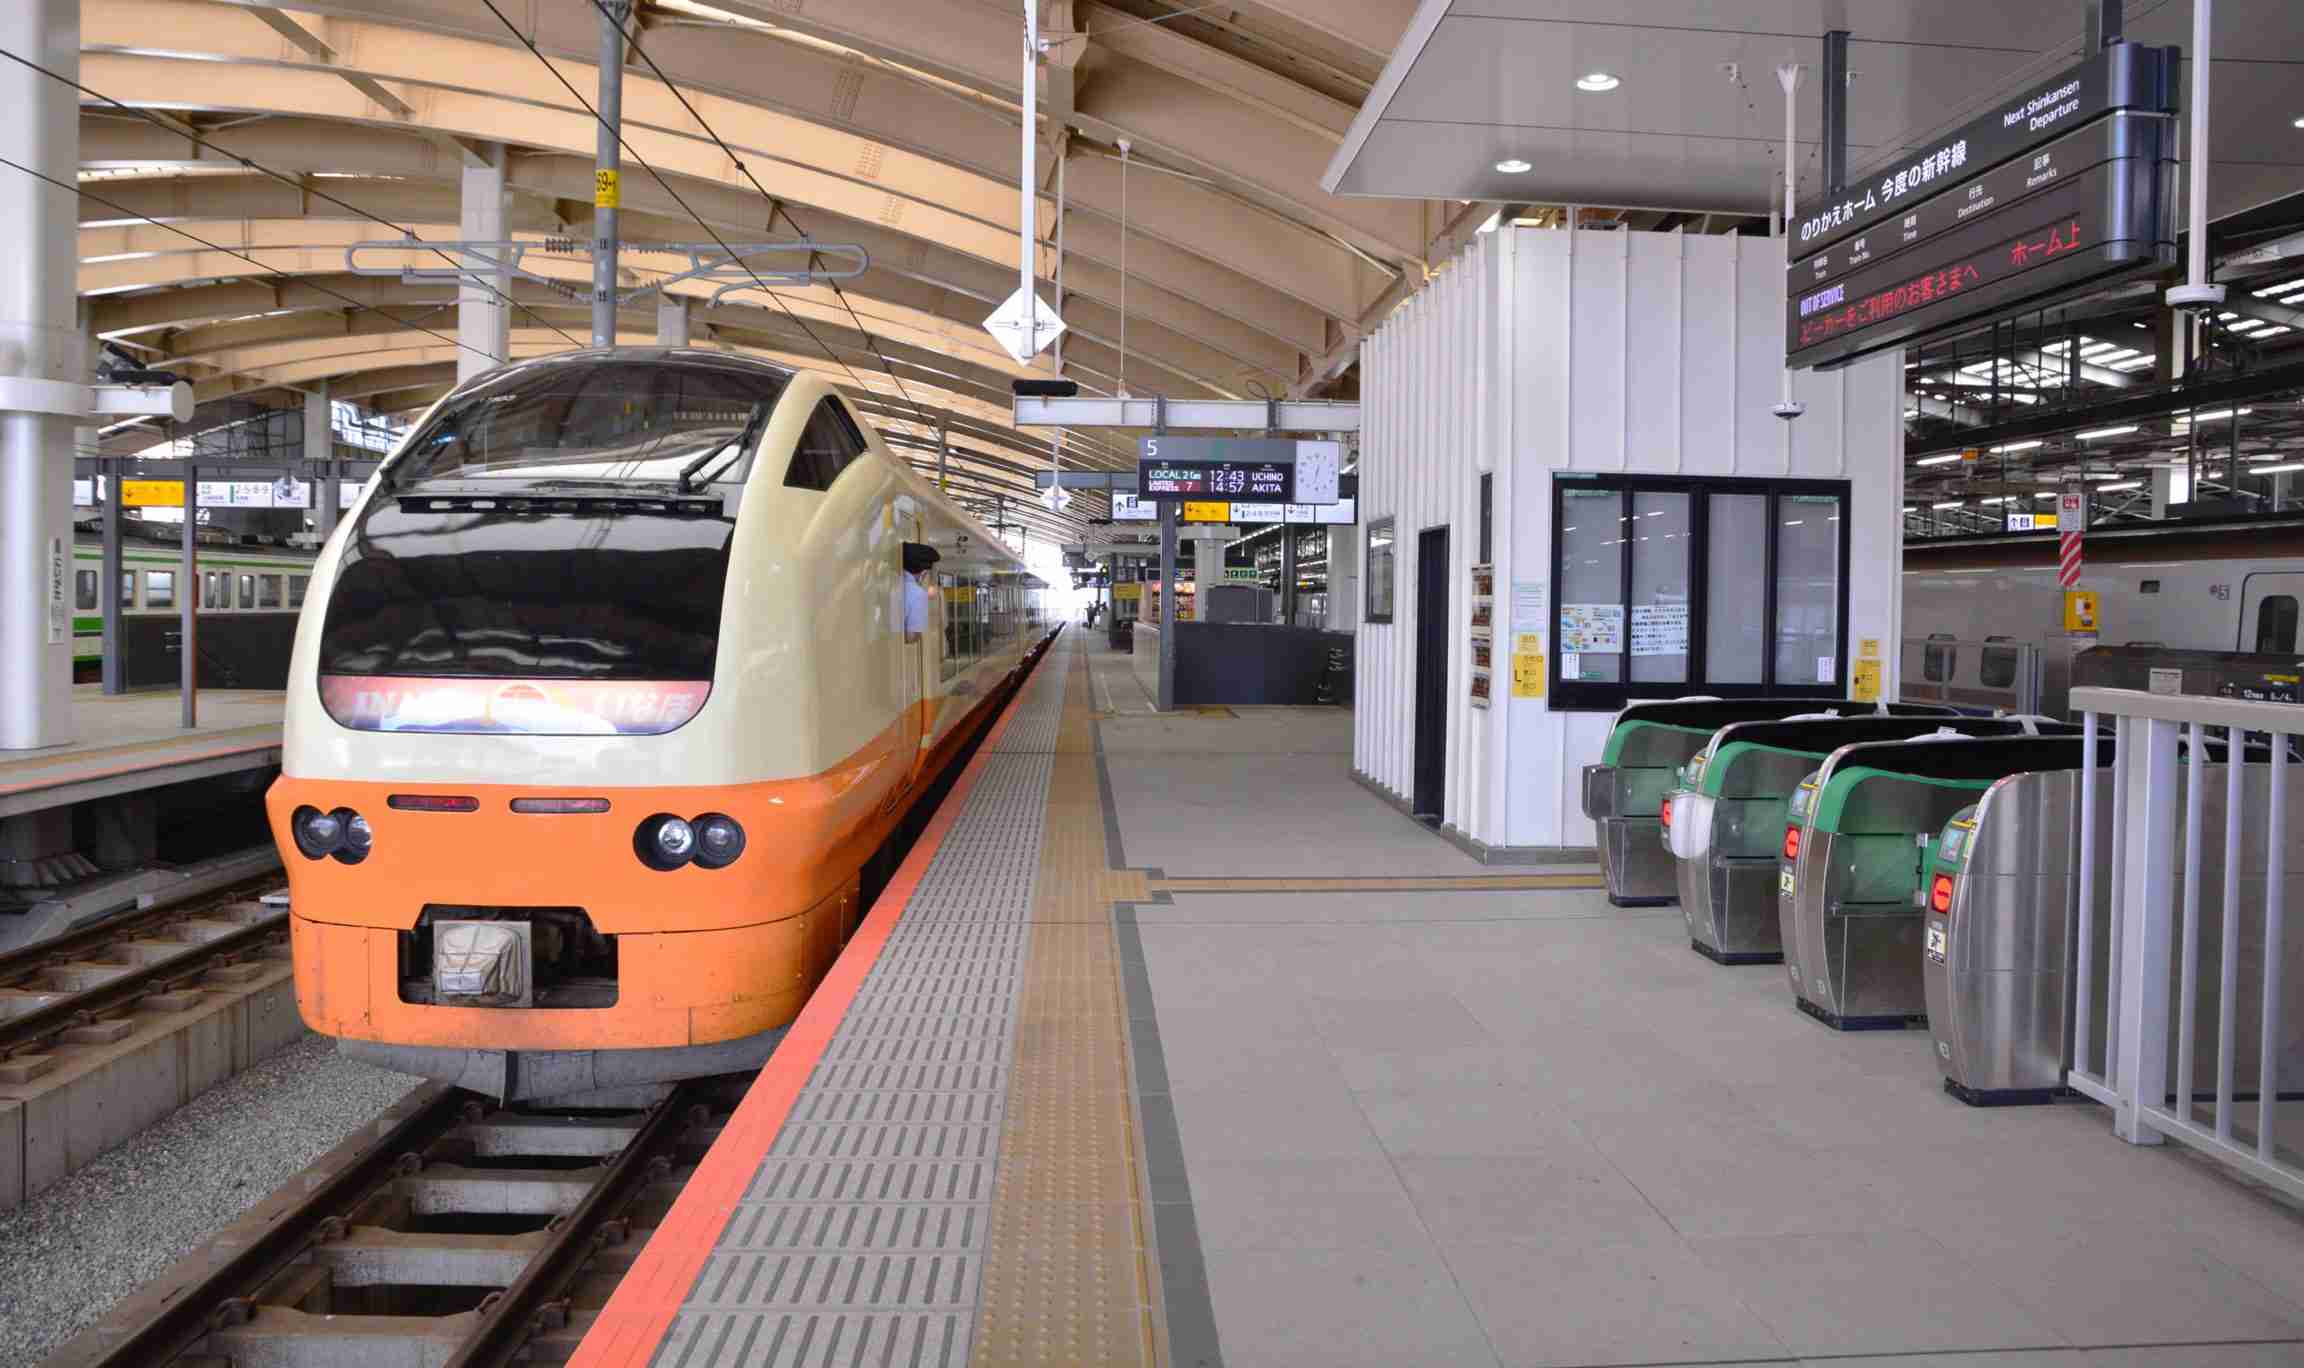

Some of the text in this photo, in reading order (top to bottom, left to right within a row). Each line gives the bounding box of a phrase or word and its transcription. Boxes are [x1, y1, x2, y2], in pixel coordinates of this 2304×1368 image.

[2003, 80, 2080, 128] Next Shinkansen
[2029, 99, 2080, 132] Departure
[2026, 168, 2058, 188] Remarks
[1800, 140, 1967, 242] のりかえホーム 今度の新幹線
[1957, 196, 1995, 219] Destination
[1147, 439, 1158, 456] 5
[1149, 469, 1182, 480] LOCAL
[1210, 470, 1245, 481] 12:43
[1251, 472, 1284, 482] UCHINO
[1186, 482, 1193, 492] 7
[1209, 481, 1245, 493] 14:57
[1251, 483, 1283, 493] AKITA
